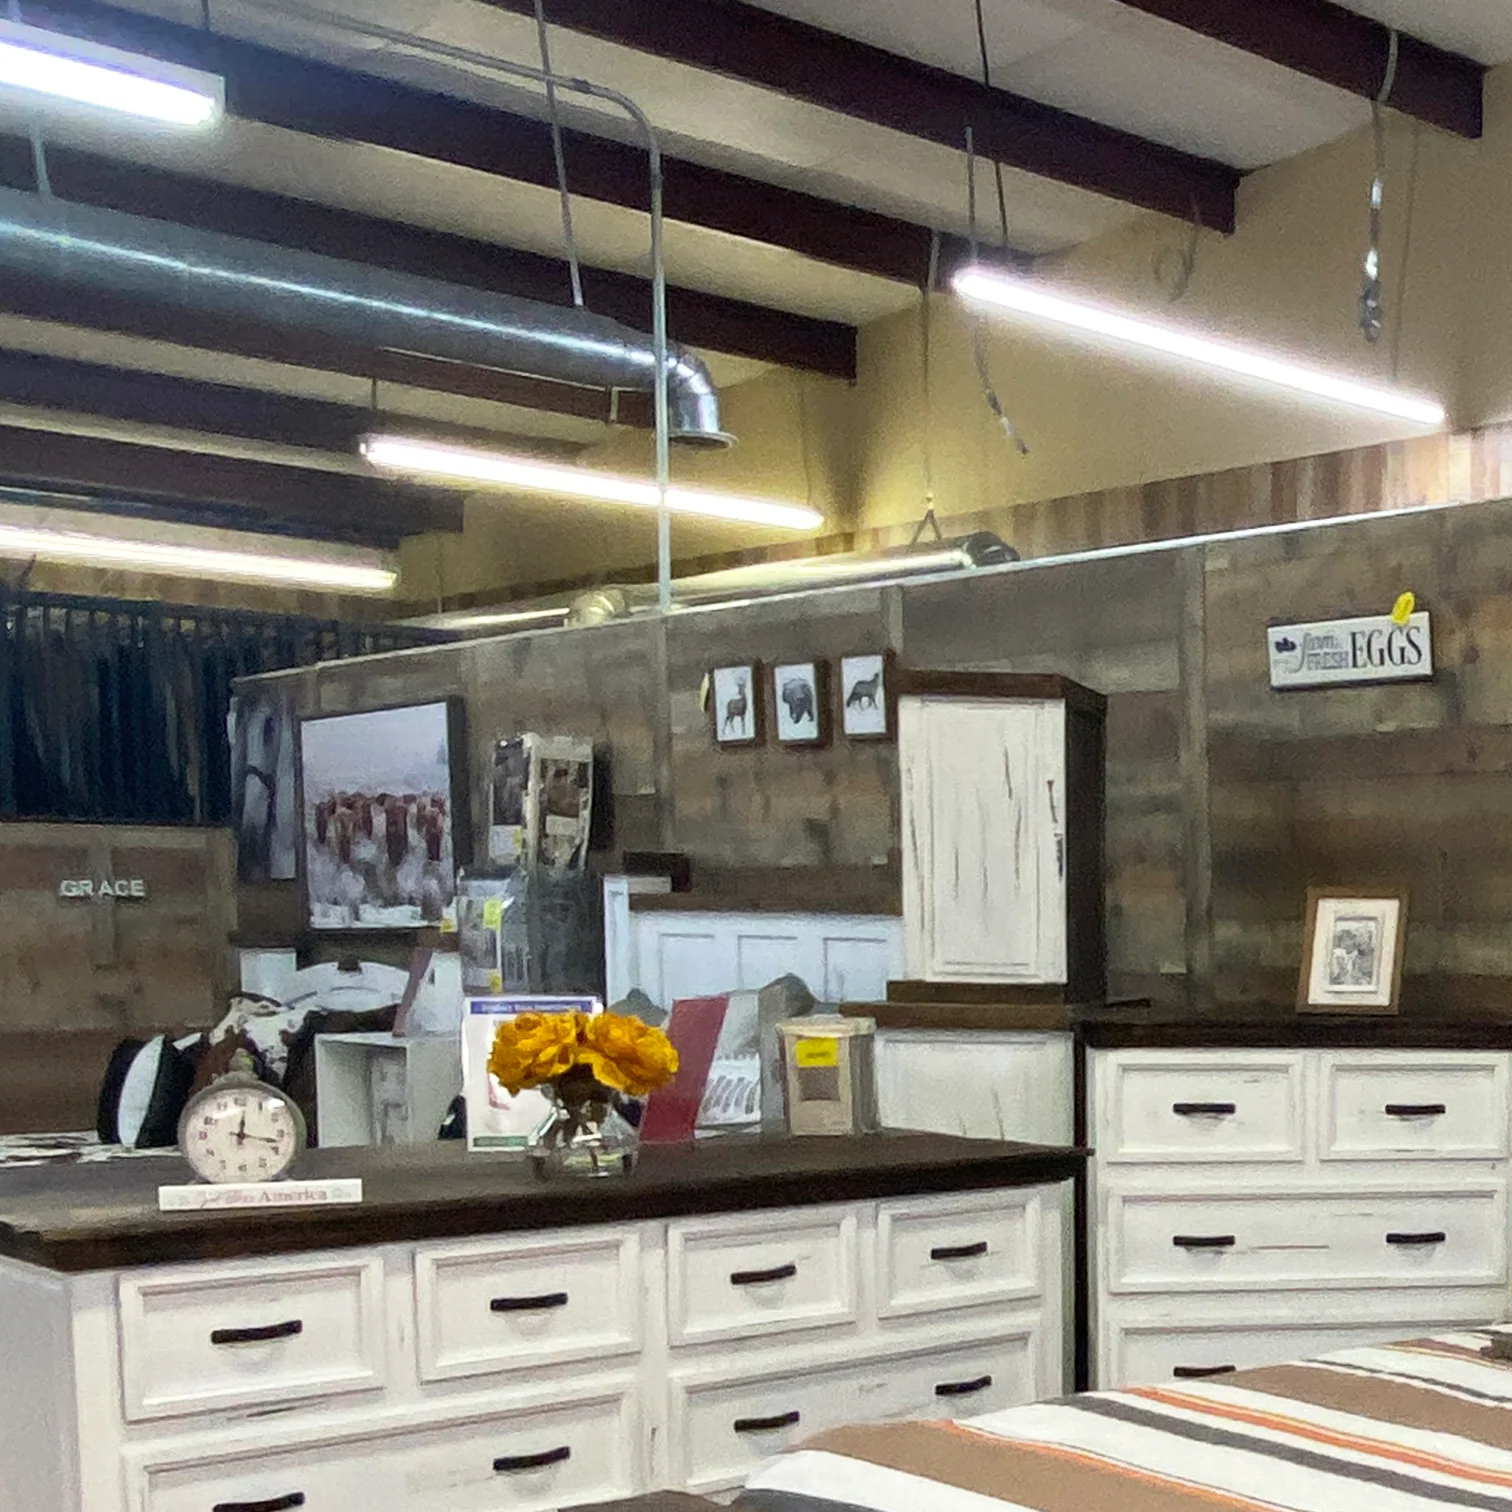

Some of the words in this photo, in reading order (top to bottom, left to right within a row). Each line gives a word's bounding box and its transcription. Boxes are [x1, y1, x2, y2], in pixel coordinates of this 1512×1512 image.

[1351, 625, 1423, 669] EGGS
[1306, 650, 1351, 671] FRESH
[60, 879, 146, 897] GRACE
[259, 1187, 328, 1204] America
